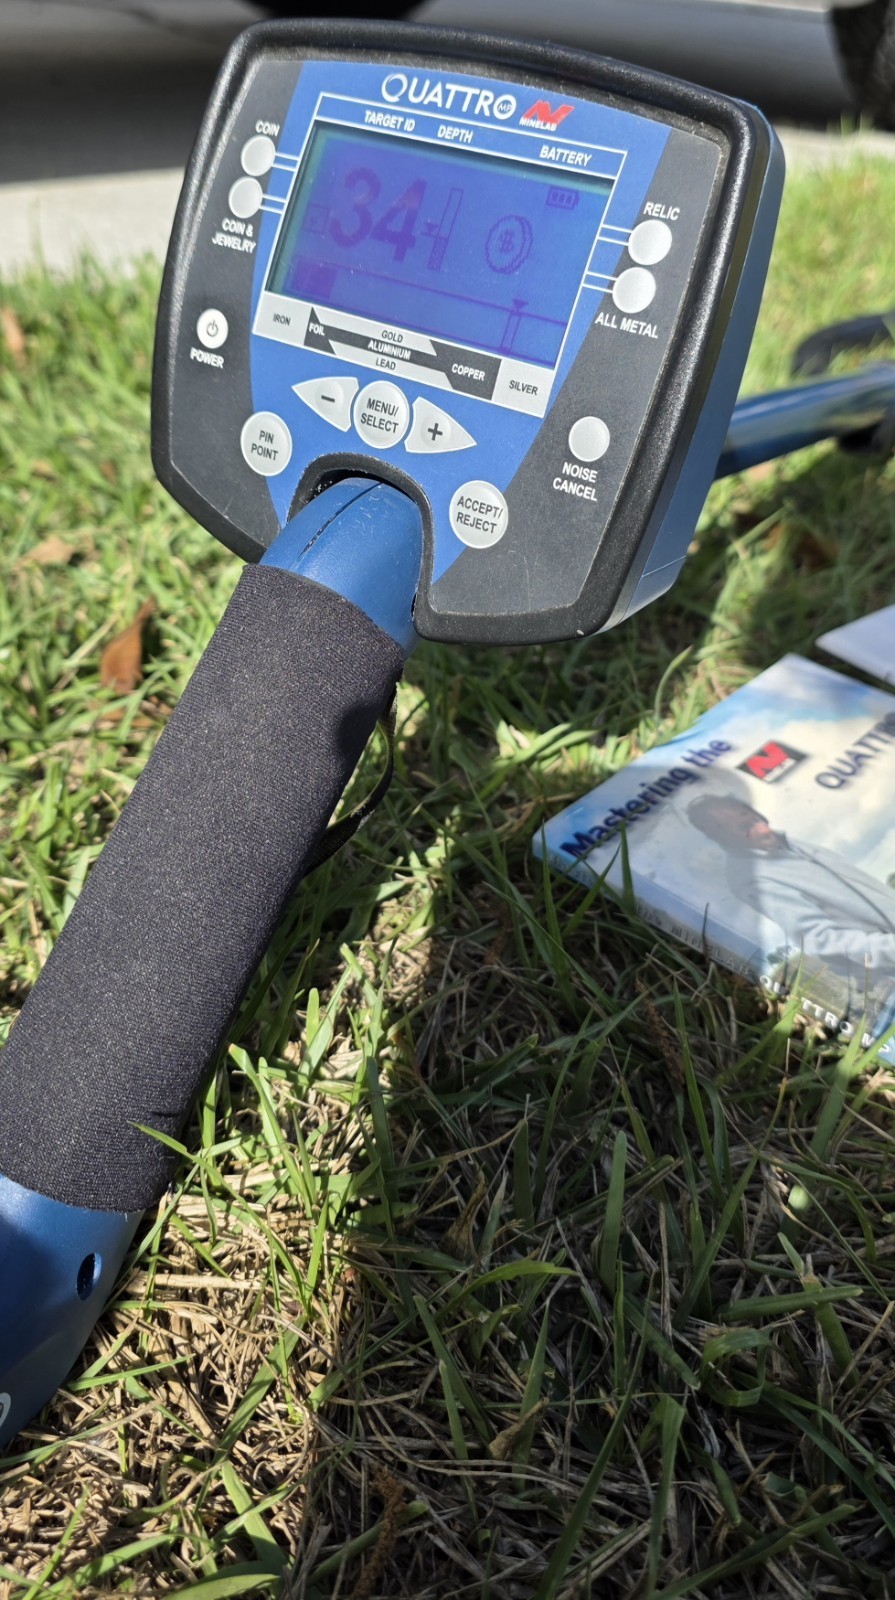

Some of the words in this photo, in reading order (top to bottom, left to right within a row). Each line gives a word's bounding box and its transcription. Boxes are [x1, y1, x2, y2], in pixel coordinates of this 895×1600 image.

[381, 73, 517, 120] QUATTRO
[255, 120, 280, 137] COIN
[364, 109, 404, 130] TARGET
[403, 117, 416, 132] ID
[519, 116, 557, 132] MINELAB
[437, 124, 474, 144] DEPTH
[539, 144, 593, 167] BATTERY
[329, 166, 428, 263] 34
[643, 201, 680, 221] RELIC
[221, 217, 246, 236] COIN
[245, 223, 254, 237] &
[211, 231, 257, 253] JEWELRY
[272, 313, 292, 326] IRON
[308, 323, 326, 336] FOIL
[594, 311, 619, 329] ALL
[619, 317, 659, 339] METAL
[381, 329, 404, 343] GOLD
[190, 347, 225, 369] POWER
[367, 339, 411, 360] ALUMINIUM
[375, 357, 397, 371] LEAD
[451, 363, 486, 382] COPPER
[508, 379, 539, 396] SILVER
[366, 397, 400, 418] MENU/
[360, 413, 400, 434] SELECT
[258, 430, 275, 444] PIN
[250, 443, 279, 461] POINT
[562, 461, 598, 484] NOISE
[552, 477, 598, 502] CANCEL
[456, 495, 504, 520] ACCEPT/
[456, 511, 498, 534] REJECT
[560, 766, 702, 861] Mastering
[681, 740, 732, 768] the
